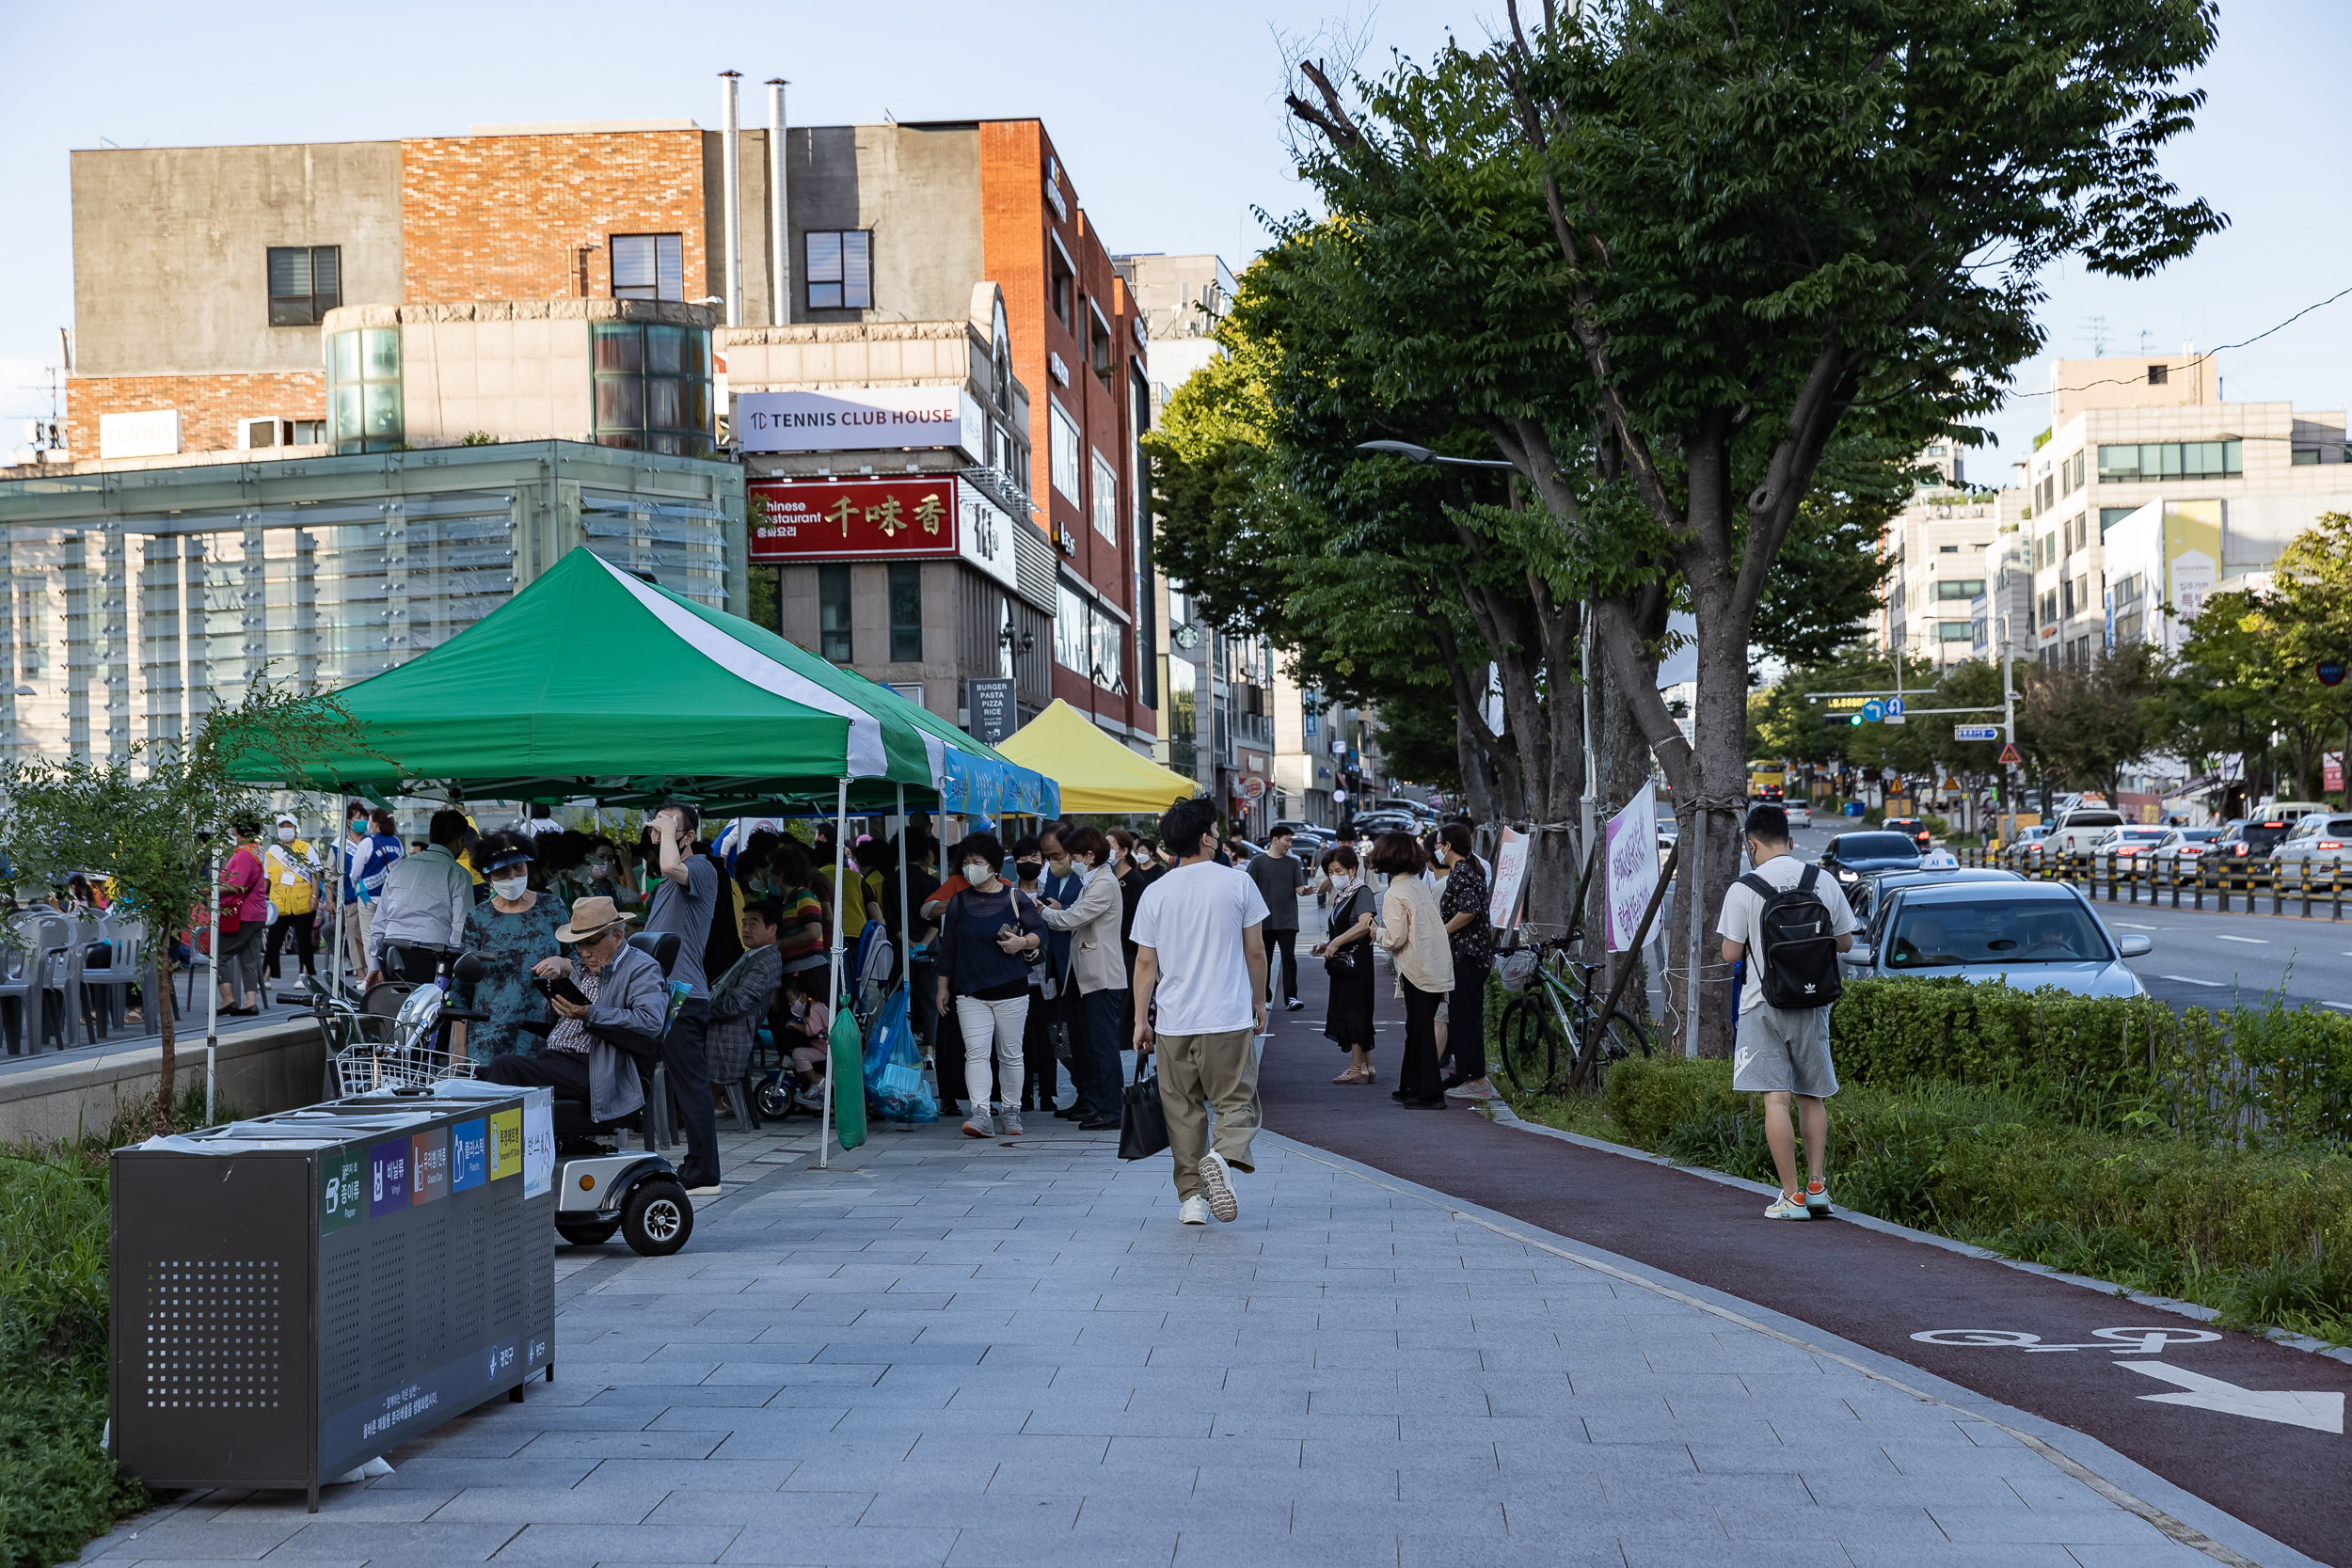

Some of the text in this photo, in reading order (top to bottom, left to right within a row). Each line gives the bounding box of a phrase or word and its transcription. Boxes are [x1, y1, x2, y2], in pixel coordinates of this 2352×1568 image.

[771, 412, 836, 428] TENNIS
[841, 410, 887, 426] CLUB
[893, 409, 953, 424] HOUSE
[757, 500, 806, 513] hinese
[824, 493, 946, 538] 千味香
[977, 683, 1008, 691] BURGER
[465, 1136, 485, 1160] 플라스틱
[387, 1158, 405, 1180] 비닐류
[469, 1162, 481, 1172] Plastic
[341, 1180, 360, 1205] 종이류
[390, 1182, 401, 1196] Vinyl
[344, 1208, 357, 1220] Paper
[500, 1346, 514, 1368] 광진구
[363, 1418, 377, 1440] 올바른
[377, 1412, 391, 1432] 재활용
